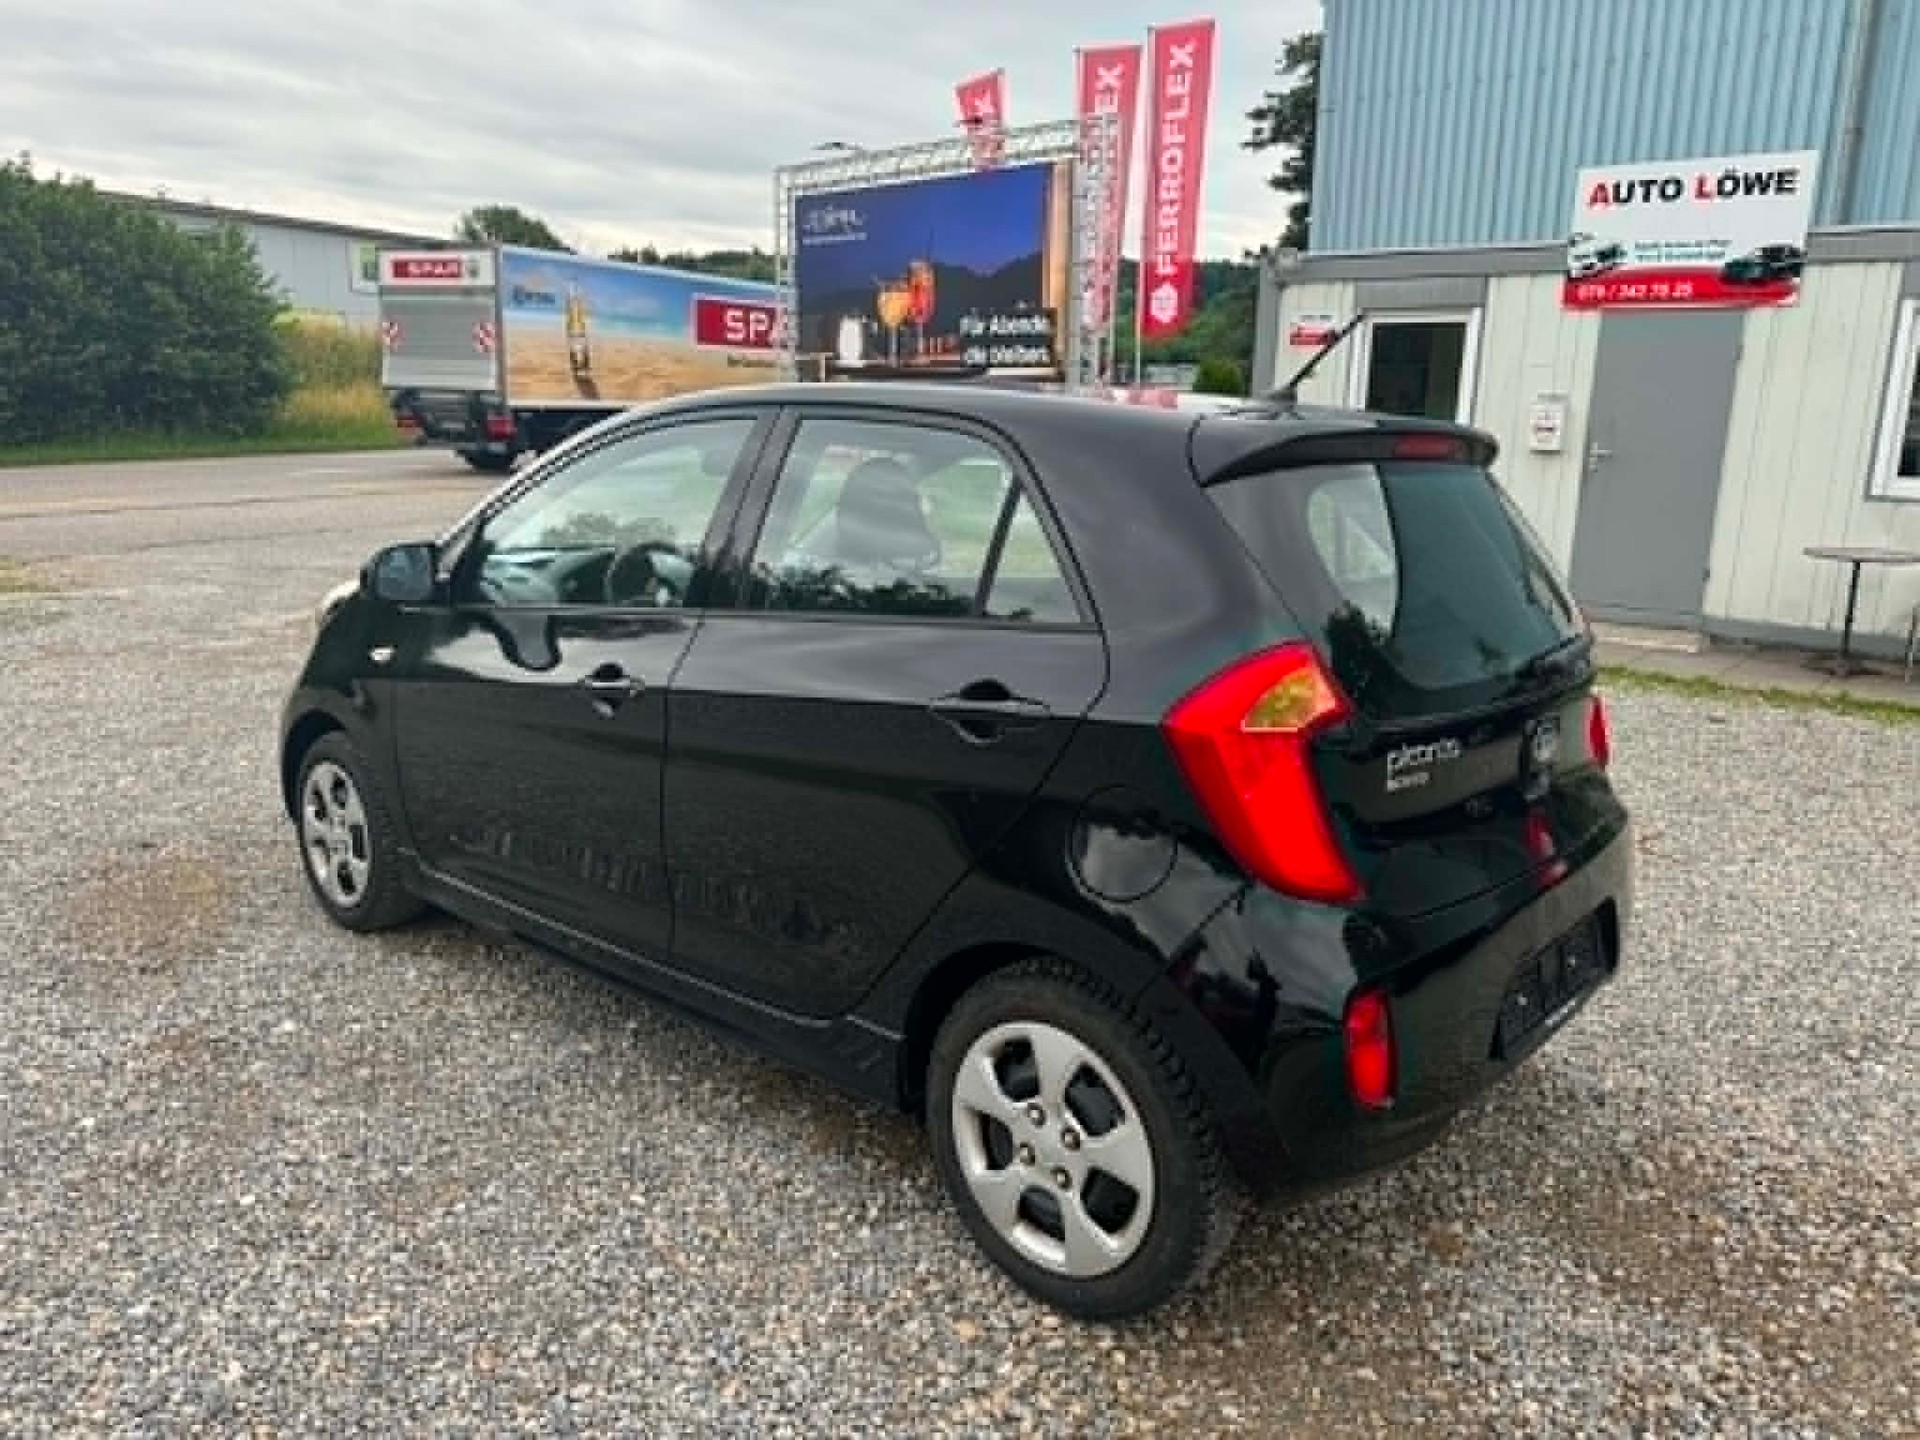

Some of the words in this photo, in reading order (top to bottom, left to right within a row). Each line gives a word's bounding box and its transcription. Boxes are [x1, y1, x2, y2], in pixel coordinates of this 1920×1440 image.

[1155, 38, 1197, 277] FERROFLEX
[1588, 176, 1683, 208] AUTO
[1695, 167, 1798, 200] LÖWE
